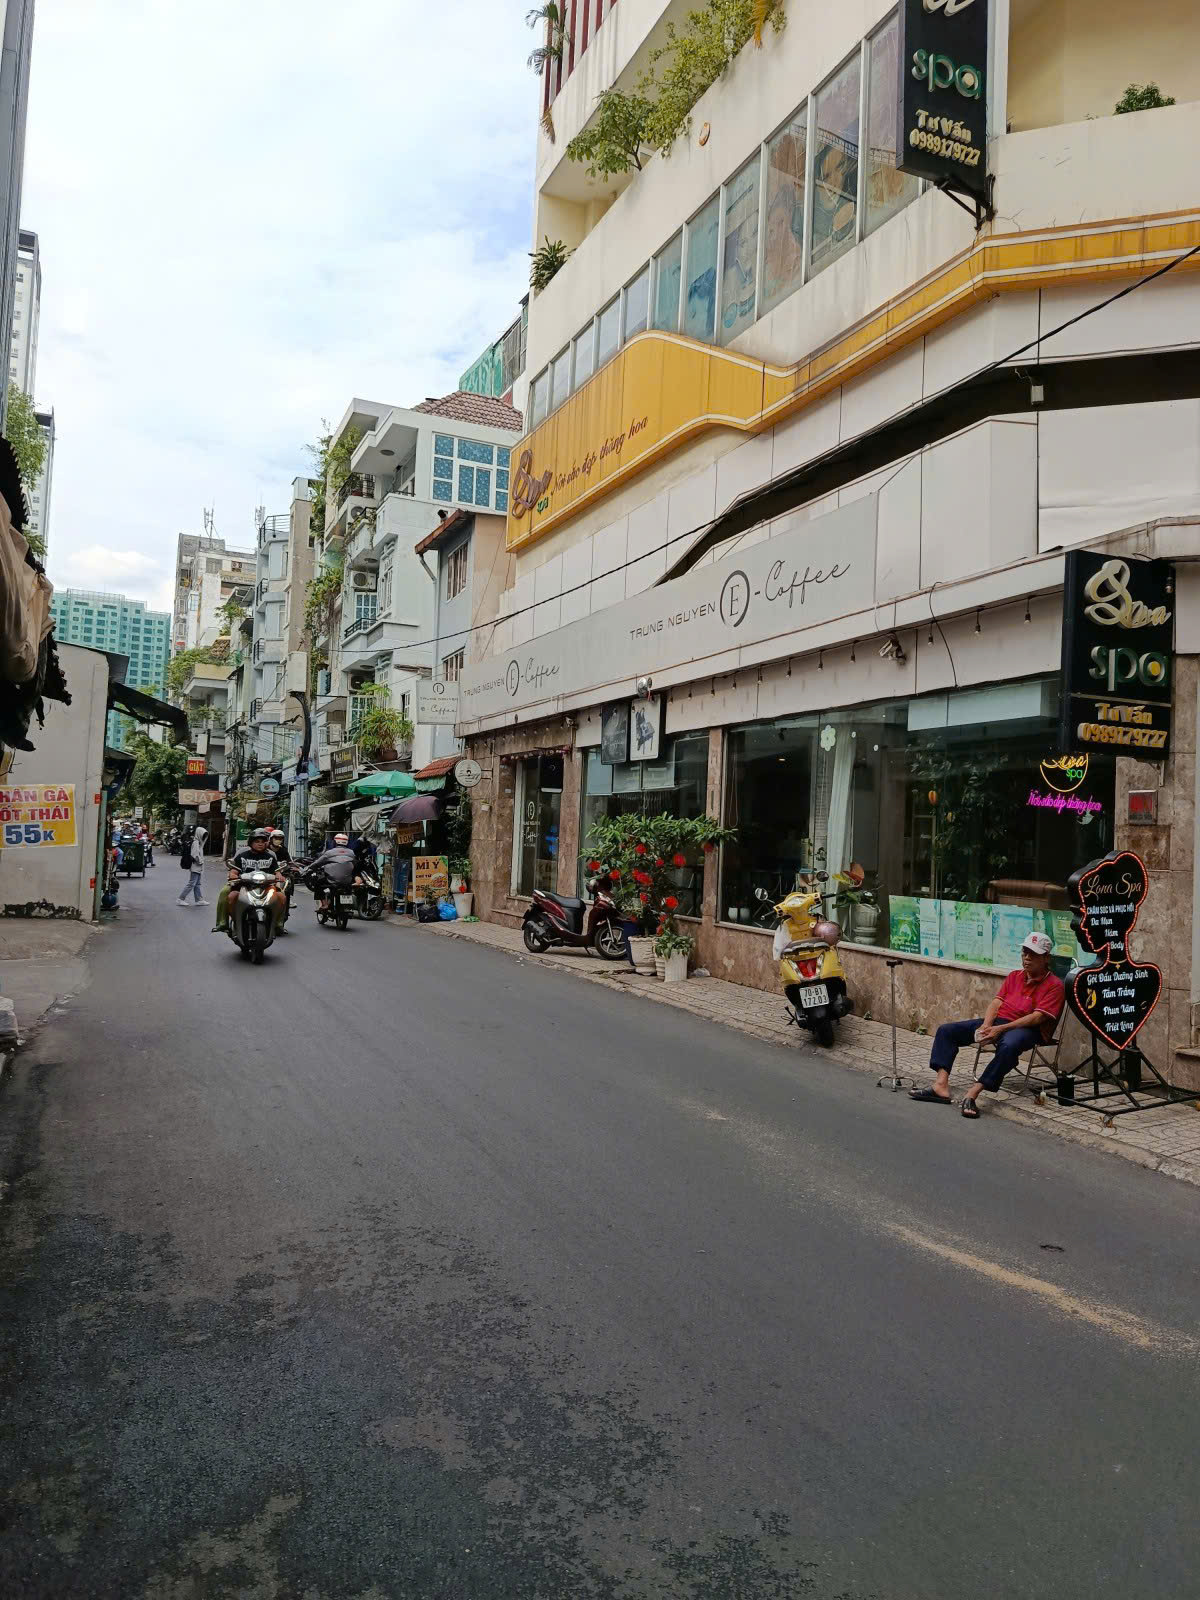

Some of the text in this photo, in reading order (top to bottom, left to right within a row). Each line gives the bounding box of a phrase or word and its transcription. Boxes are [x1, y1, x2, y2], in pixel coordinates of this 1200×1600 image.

[912, 49, 982, 100] spa
[909, 128, 981, 167] 0989179727
[628, 416, 649, 440] hoa
[630, 620, 664, 641] TRUNG
[667, 601, 716, 628] NGUYEN
[1089, 645, 1169, 692] spa
[1077, 723, 1168, 748] 0989179727
[1066, 768, 1083, 781] spa
[44, 786, 70, 802] GÀ
[28, 805, 70, 821] THÁI
[1084, 872, 1142, 901] Lona Spa
[1110, 940, 1125, 951] Body
[1134, 969, 1149, 979] Sinh
[1103, 1006, 1120, 1016] Phun
